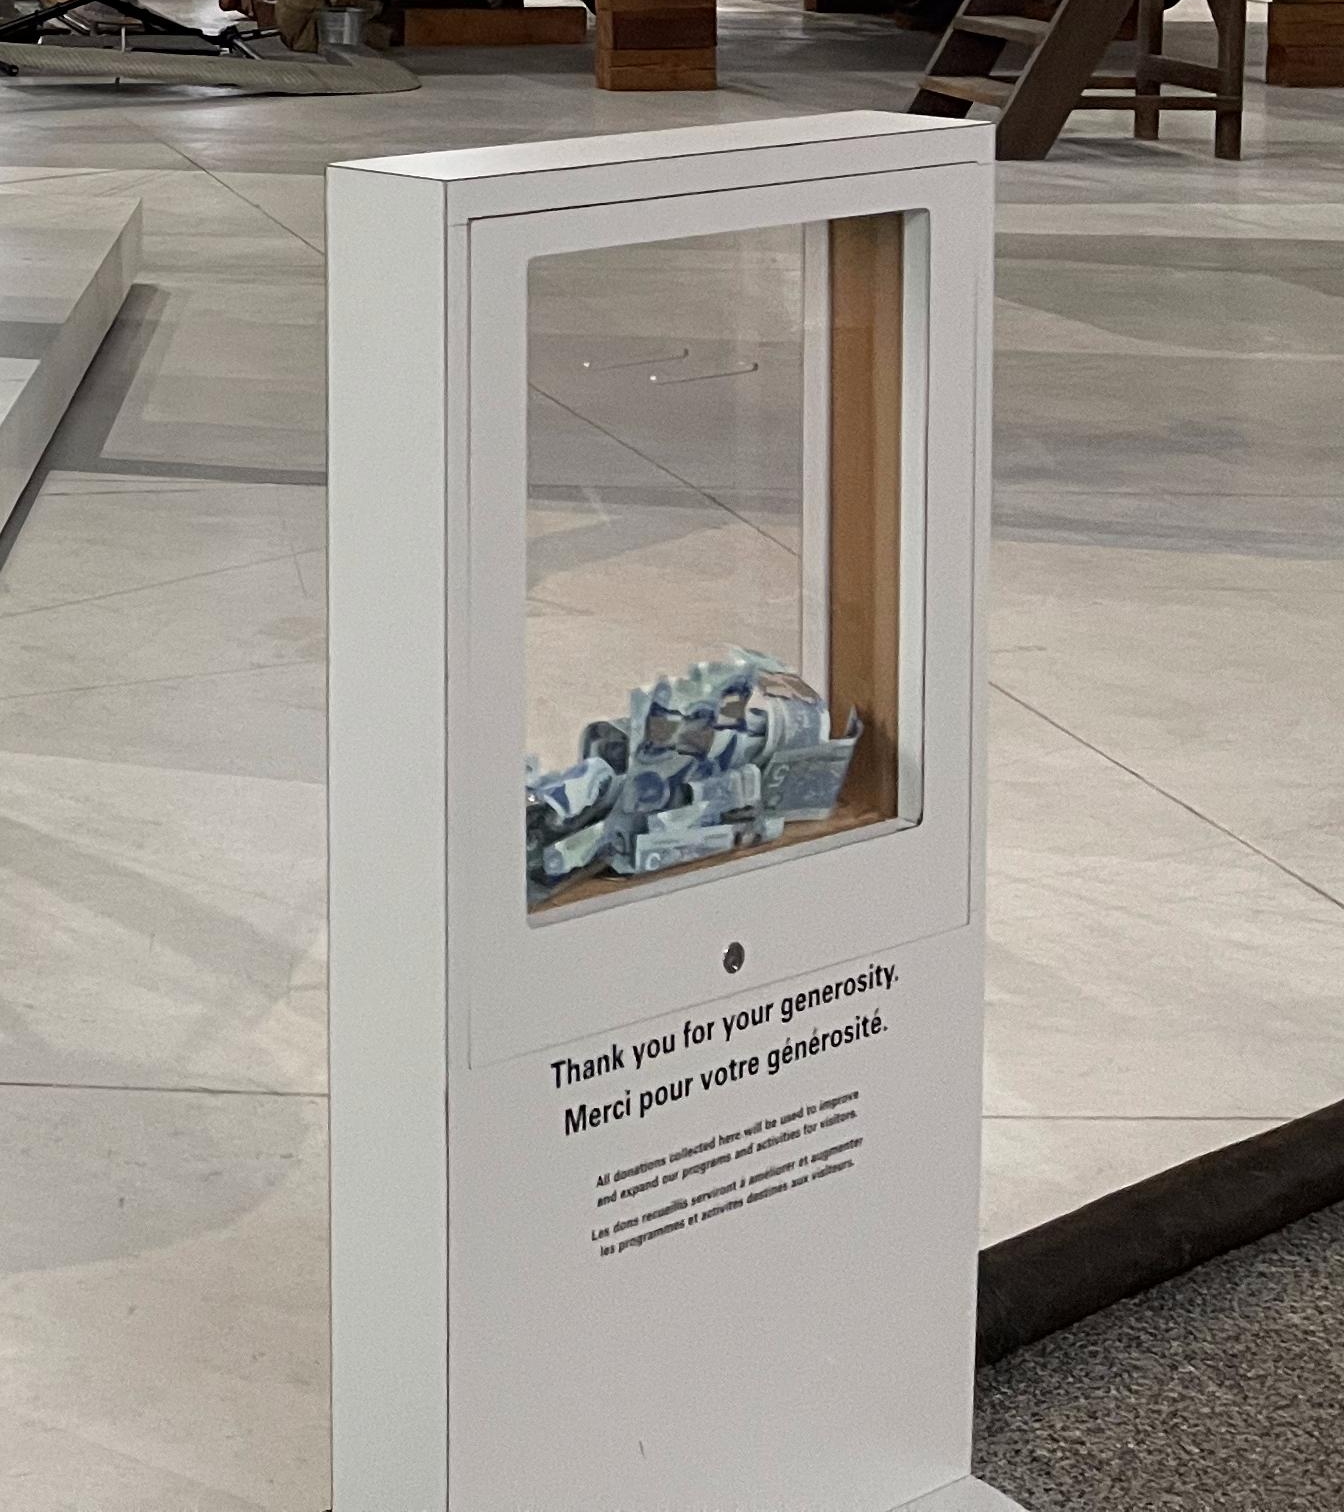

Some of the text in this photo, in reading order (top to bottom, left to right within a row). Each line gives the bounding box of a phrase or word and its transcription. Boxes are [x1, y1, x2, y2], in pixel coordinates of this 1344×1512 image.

[551, 963, 899, 1088] Thank you for your generosity.
[565, 1008, 888, 1136] Merci pour votre générosité.
[596, 1091, 859, 1187] All donations collected here will be used to improve
[597, 1190, 617, 1207] and
[620, 1176, 659, 1198] expand
[662, 1170, 679, 1184] our
[682, 1153, 731, 1180] programs
[735, 1142, 754, 1159] and
[756, 1129, 801, 1152] activities
[803, 1123, 818, 1135] for
[591, 1227, 610, 1241] Les
[613, 1217, 639, 1233] dons
[642, 1199, 688, 1224] recueillis
[691, 1181, 737, 1206] serviront
[798, 1155, 809, 1167] et
[600, 1245, 615, 1257] les
[618, 1219, 685, 1253] programmes
[688, 1213, 698, 1226] et
[791, 1175, 809, 1188] aux
